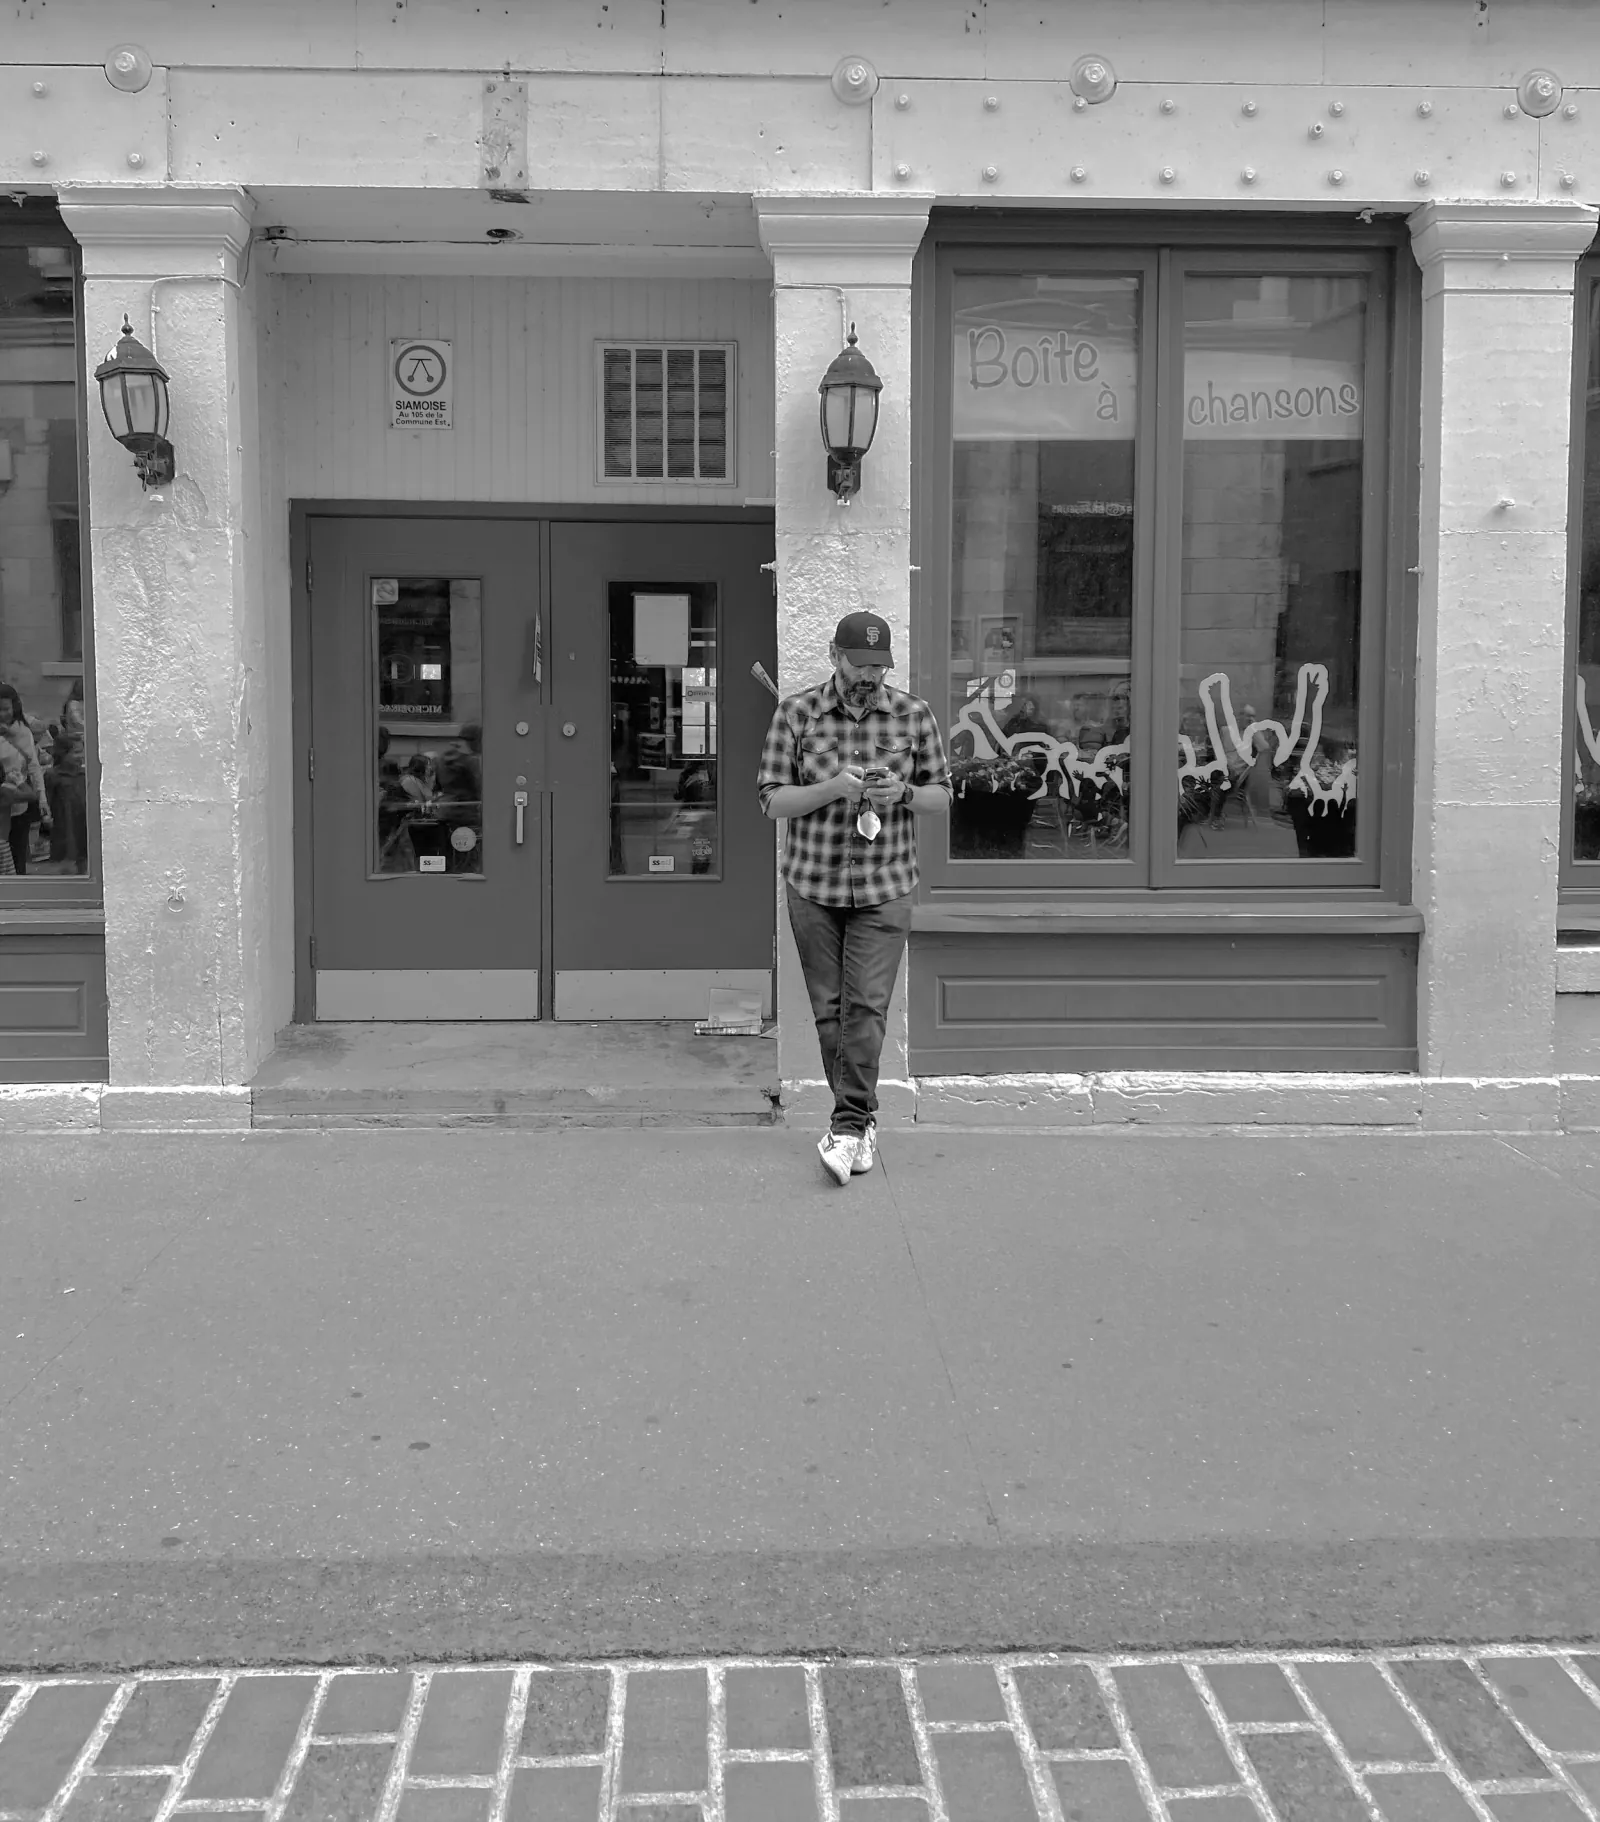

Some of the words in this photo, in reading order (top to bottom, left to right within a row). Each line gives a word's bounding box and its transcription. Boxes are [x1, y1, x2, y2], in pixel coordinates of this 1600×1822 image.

[968, 327, 1100, 389] Boîte
[395, 400, 446, 411] SIAMOISE
[1096, 382, 1119, 422] à
[1188, 381, 1358, 425] chansons
[395, 417, 433, 425] Commune
